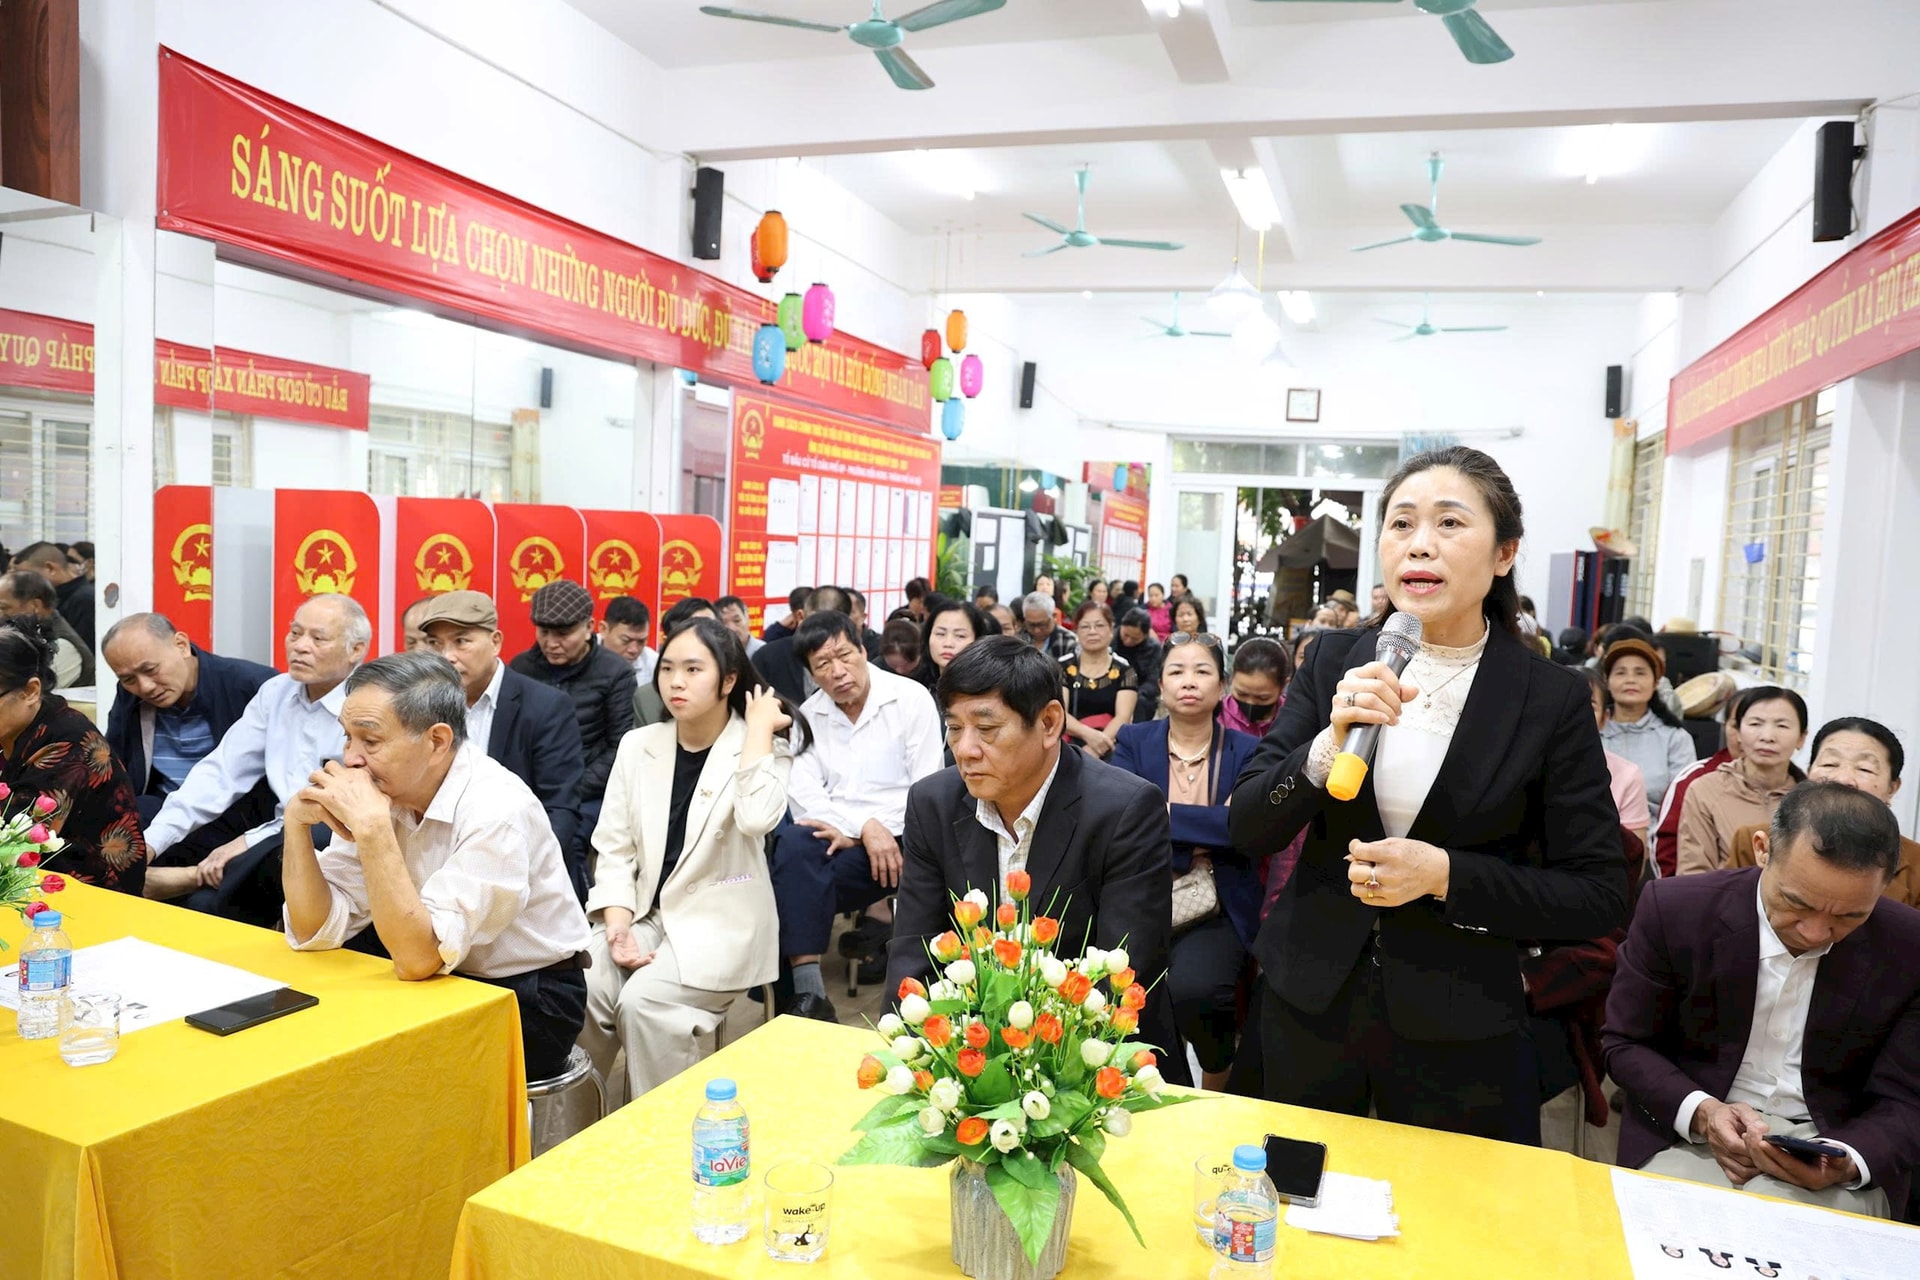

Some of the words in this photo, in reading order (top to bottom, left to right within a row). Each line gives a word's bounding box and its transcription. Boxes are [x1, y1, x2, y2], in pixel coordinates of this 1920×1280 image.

[231, 123, 325, 223] SÁNG
[330, 162, 407, 248] SUỐT
[411, 200, 460, 273] LỰA
[465, 221, 527, 293] CHỌN
[602, 268, 655, 326] NGƯỜI
[658, 274, 679, 334] ĐỦ
